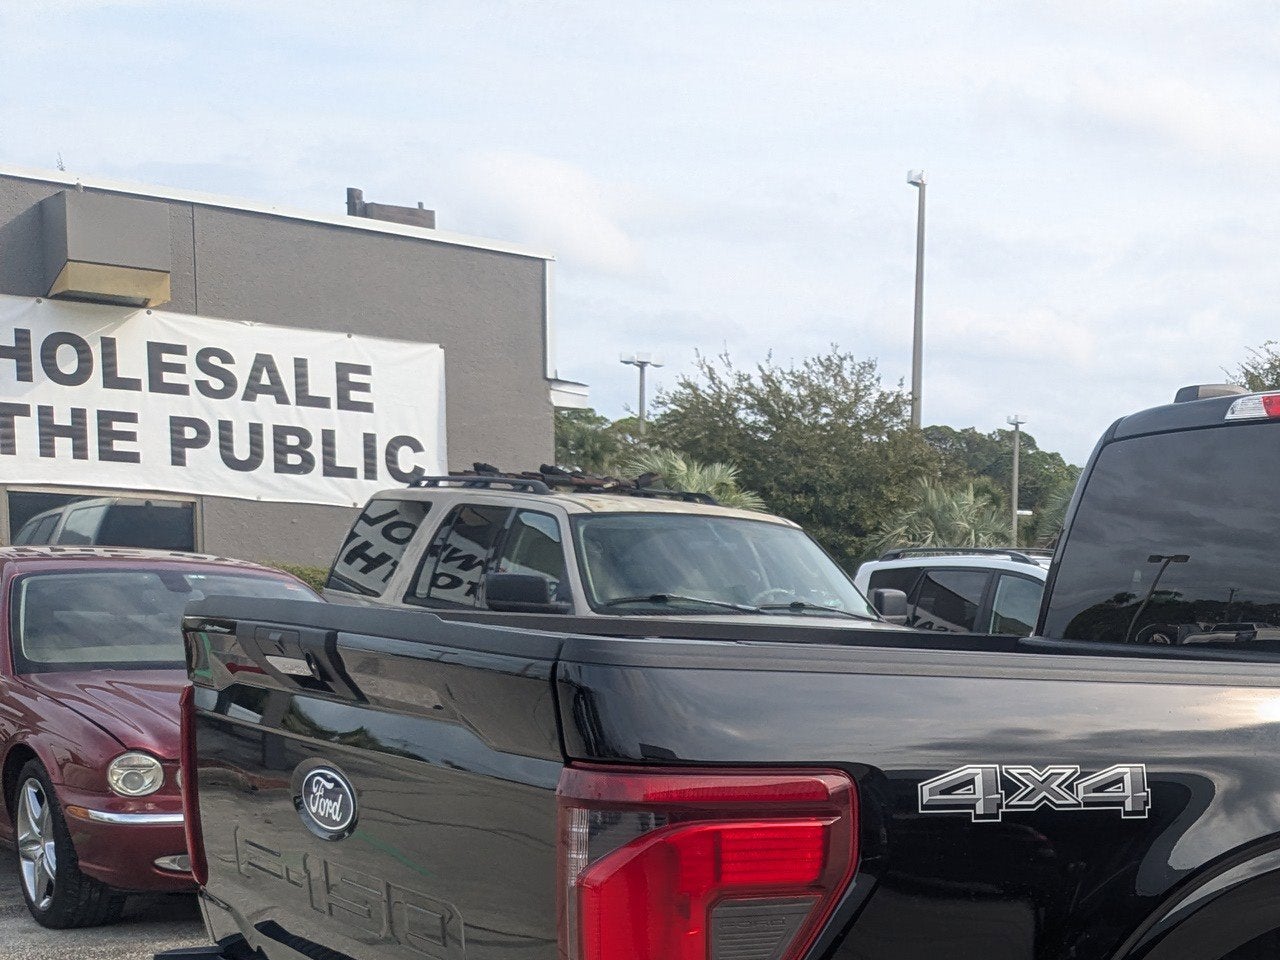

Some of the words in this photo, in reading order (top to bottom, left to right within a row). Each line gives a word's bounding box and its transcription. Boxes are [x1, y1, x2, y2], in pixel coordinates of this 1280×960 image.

[0, 328, 374, 413] HOLESALE
[0, 402, 141, 464] THE
[169, 415, 426, 484] PUBLIC
[311, 776, 342, 822] Ford
